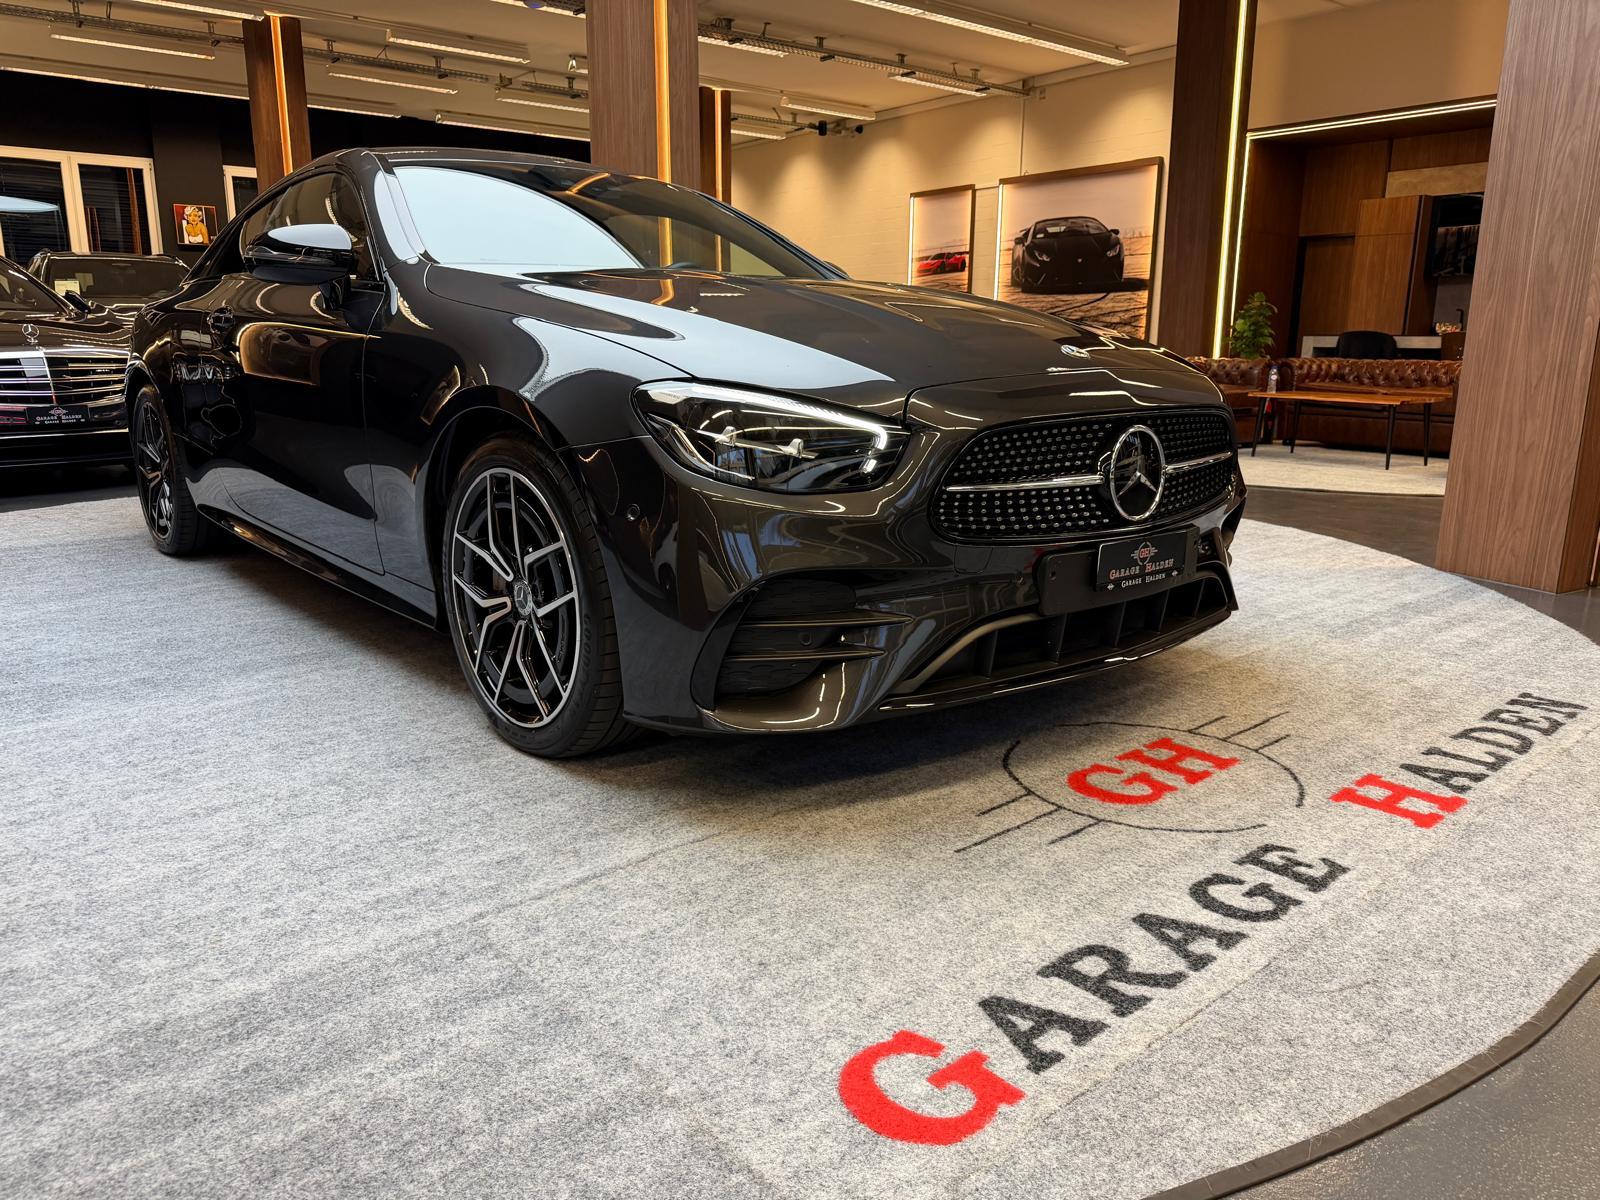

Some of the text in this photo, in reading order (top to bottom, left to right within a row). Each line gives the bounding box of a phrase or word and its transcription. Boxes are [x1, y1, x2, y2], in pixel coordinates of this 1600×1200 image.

[1109, 559, 1174, 579] GARAGE HALDEN
[1121, 573, 1166, 588] GARAGE HALDEN
[1067, 737, 1242, 805] GH
[839, 692, 1588, 1145] GARAGE HALDEN
